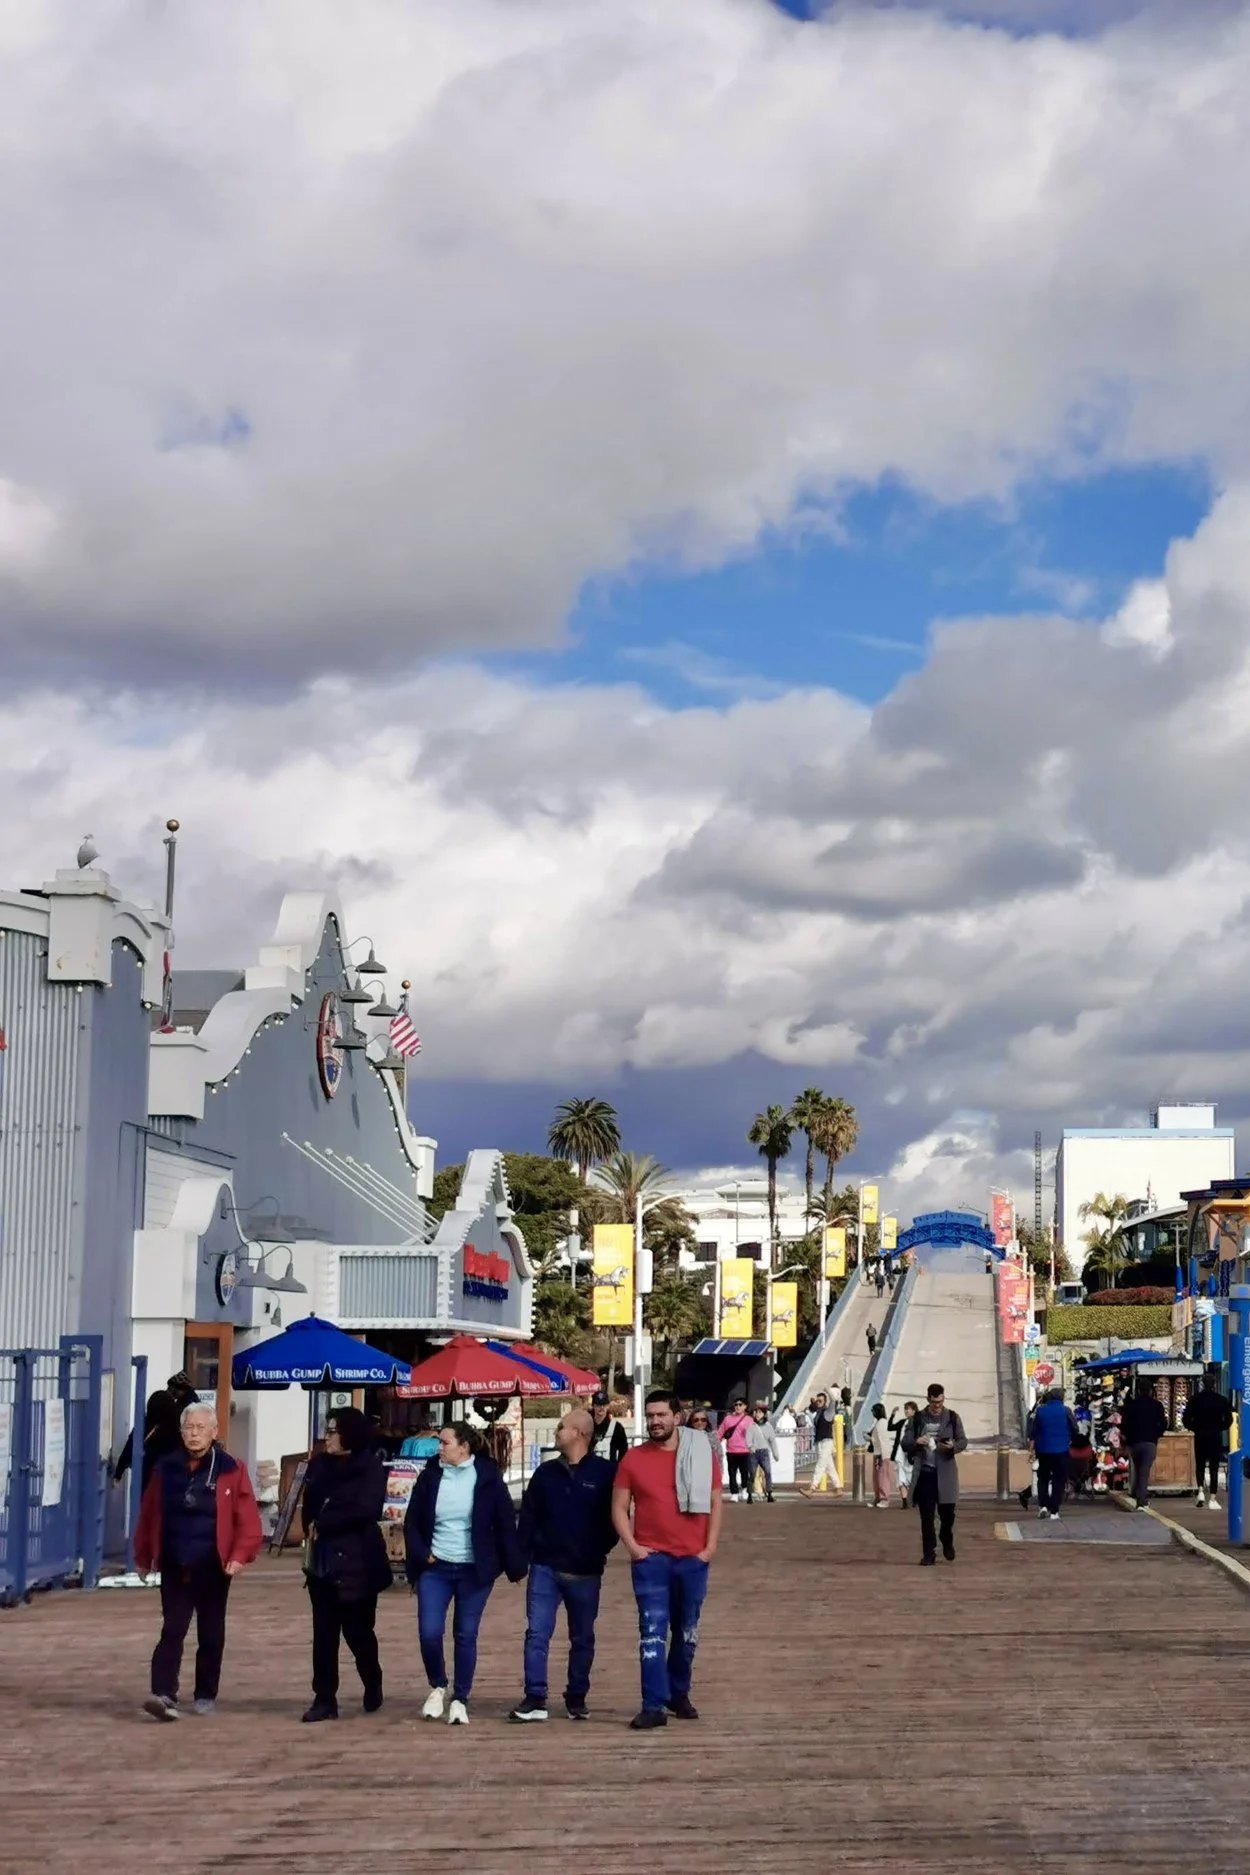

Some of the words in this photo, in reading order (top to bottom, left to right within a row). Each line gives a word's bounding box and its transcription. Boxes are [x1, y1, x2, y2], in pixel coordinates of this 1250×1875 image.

[255, 1370, 289, 1380] BUBBA
[292, 1368, 322, 1379] GUMP
[335, 1369, 369, 1379] SHRIMP
[370, 1368, 386, 1379] CO.
[1034, 1368, 1054, 1379] STOP
[432, 1383, 447, 1393] CO.
[459, 1381, 488, 1391] BUBBA
[489, 1379, 514, 1390] GUMP
